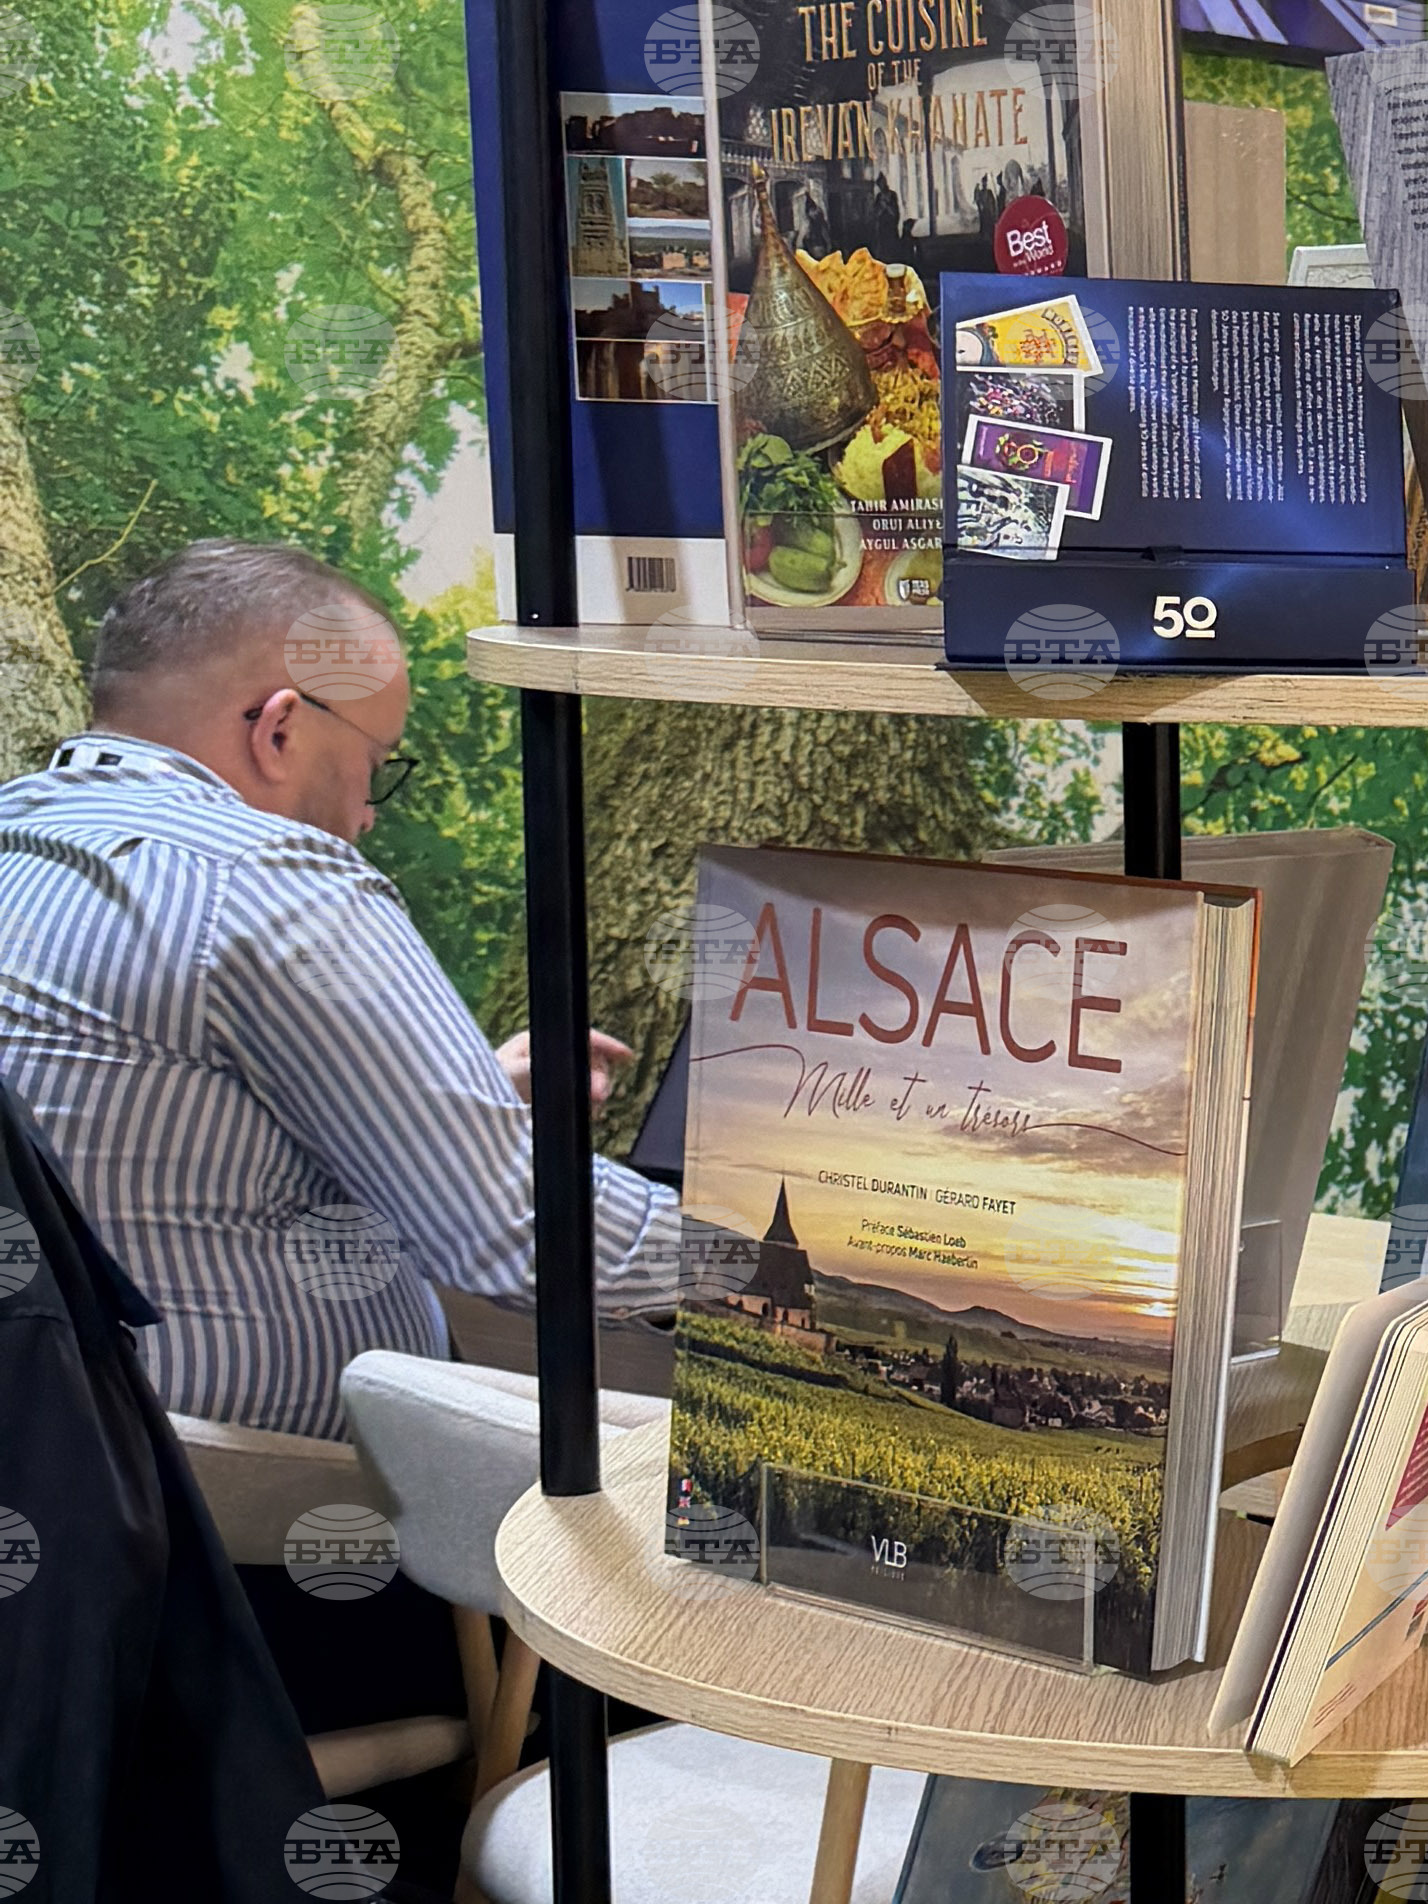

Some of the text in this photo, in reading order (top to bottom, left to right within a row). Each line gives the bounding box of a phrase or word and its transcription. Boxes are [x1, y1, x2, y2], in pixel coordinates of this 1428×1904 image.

[797, 1, 857, 63] THE
[867, 58, 922, 91] OF THE
[770, 99, 878, 162] IREVAN
[1005, 219, 1053, 257] Best
[850, 499, 888, 513] TAHIR
[860, 538, 900, 551] AYGUL
[1153, 595, 1217, 640] 50
[729, 900, 1129, 1075] ALSACE
[784, 1061, 875, 1119] Mille
[889, 1071, 927, 1121] et
[926, 1102, 950, 1120] un
[818, 1169, 1017, 1216] CHRISTEL DURANTIN GÉRARD FAYET
[870, 1534, 908, 1569] VLB
